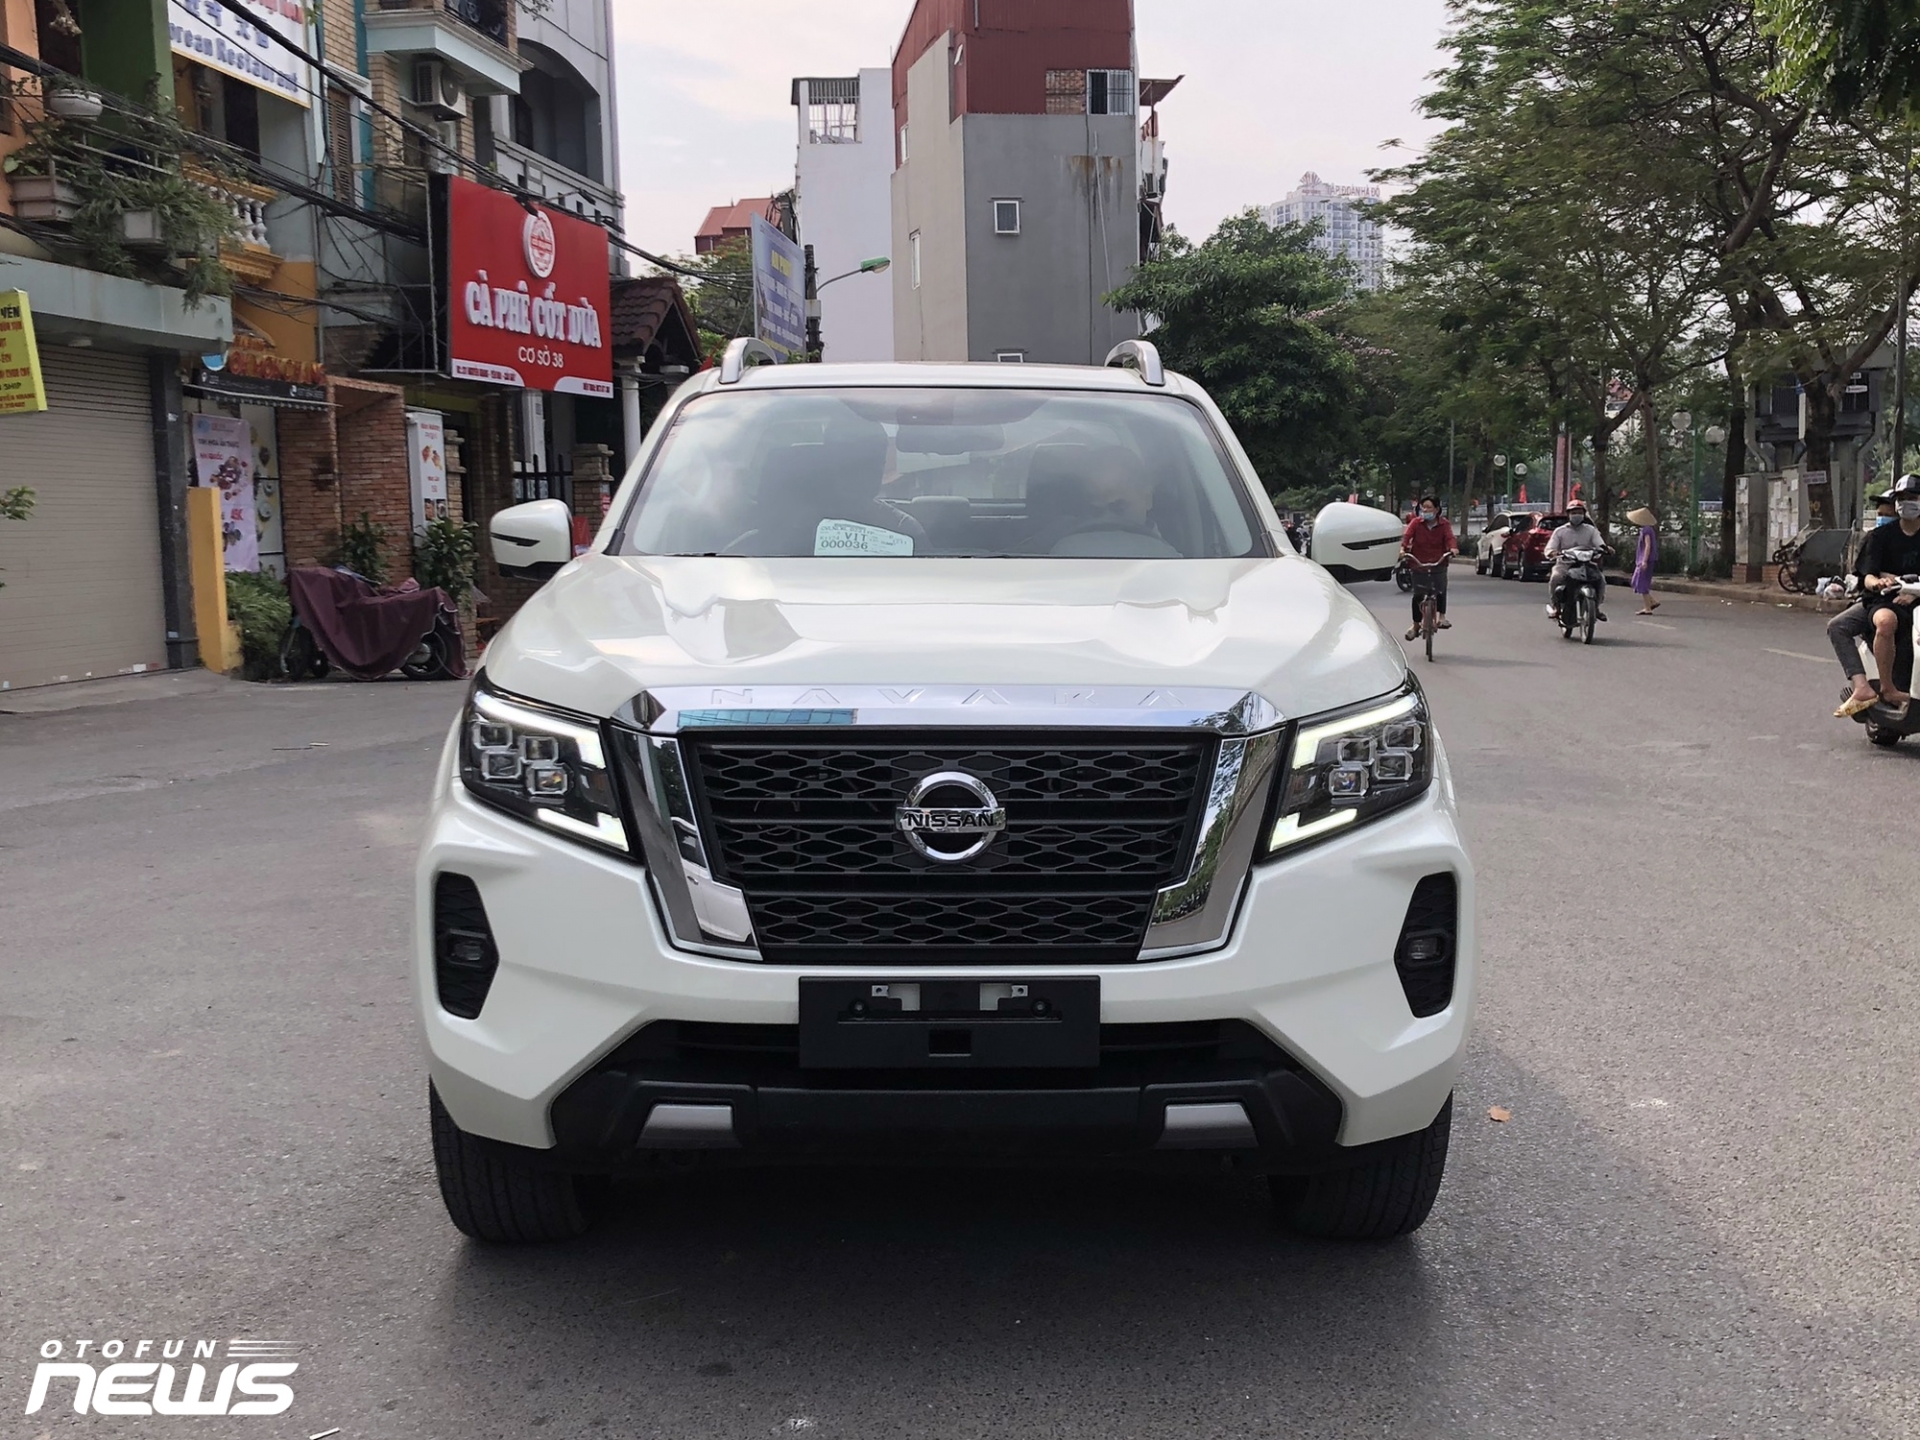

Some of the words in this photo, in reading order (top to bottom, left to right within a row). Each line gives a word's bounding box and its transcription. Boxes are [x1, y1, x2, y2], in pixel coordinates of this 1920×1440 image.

[465, 269, 494, 327] CÀ
[493, 280, 531, 335] PHÊ
[532, 281, 567, 341] CỐT
[567, 296, 602, 348] DỪA
[518, 346, 536, 364] CƠ
[537, 344, 551, 367] SỞ
[552, 352, 564, 368] 38
[820, 539, 869, 550] 000036
[844, 532, 868, 542] VIT
[711, 686, 1186, 706] NAVARA
[907, 813, 994, 827] NISSAN
